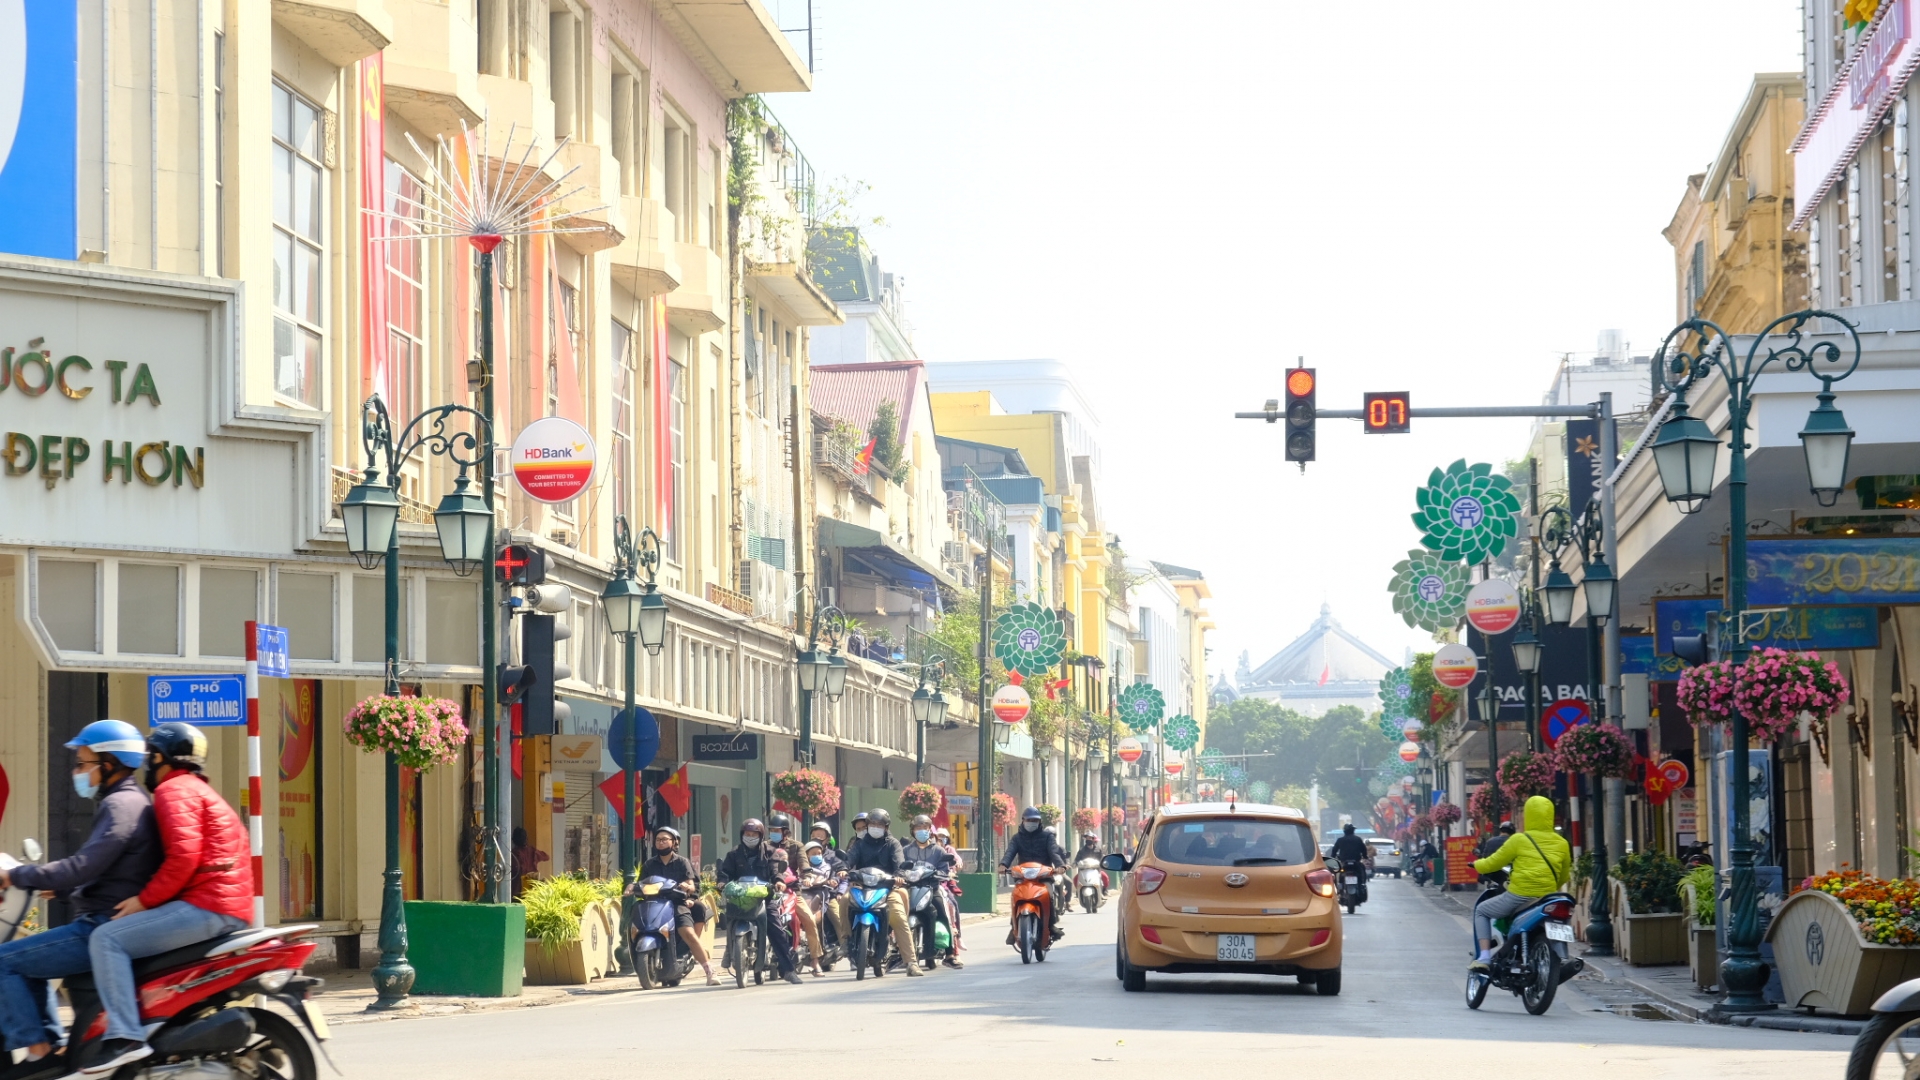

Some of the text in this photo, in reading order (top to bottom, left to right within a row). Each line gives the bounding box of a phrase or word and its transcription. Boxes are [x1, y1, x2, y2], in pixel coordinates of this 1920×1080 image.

[105, 360, 162, 406] TA
[1370, 399, 1404, 426] 07
[524, 447, 573, 459] HDBank
[1, 431, 204, 490] ĐẸP HƠN
[1474, 598, 1506, 606] HDBank
[267, 632, 280, 644] PHỐ
[190, 680, 220, 693] PHỐ
[157, 697, 239, 719] ĐINH TIÊN HOÀNG
[700, 742, 749, 753] BOOZILLA
[1226, 936, 1246, 947] 30A
[1218, 949, 1254, 960] 930.45
